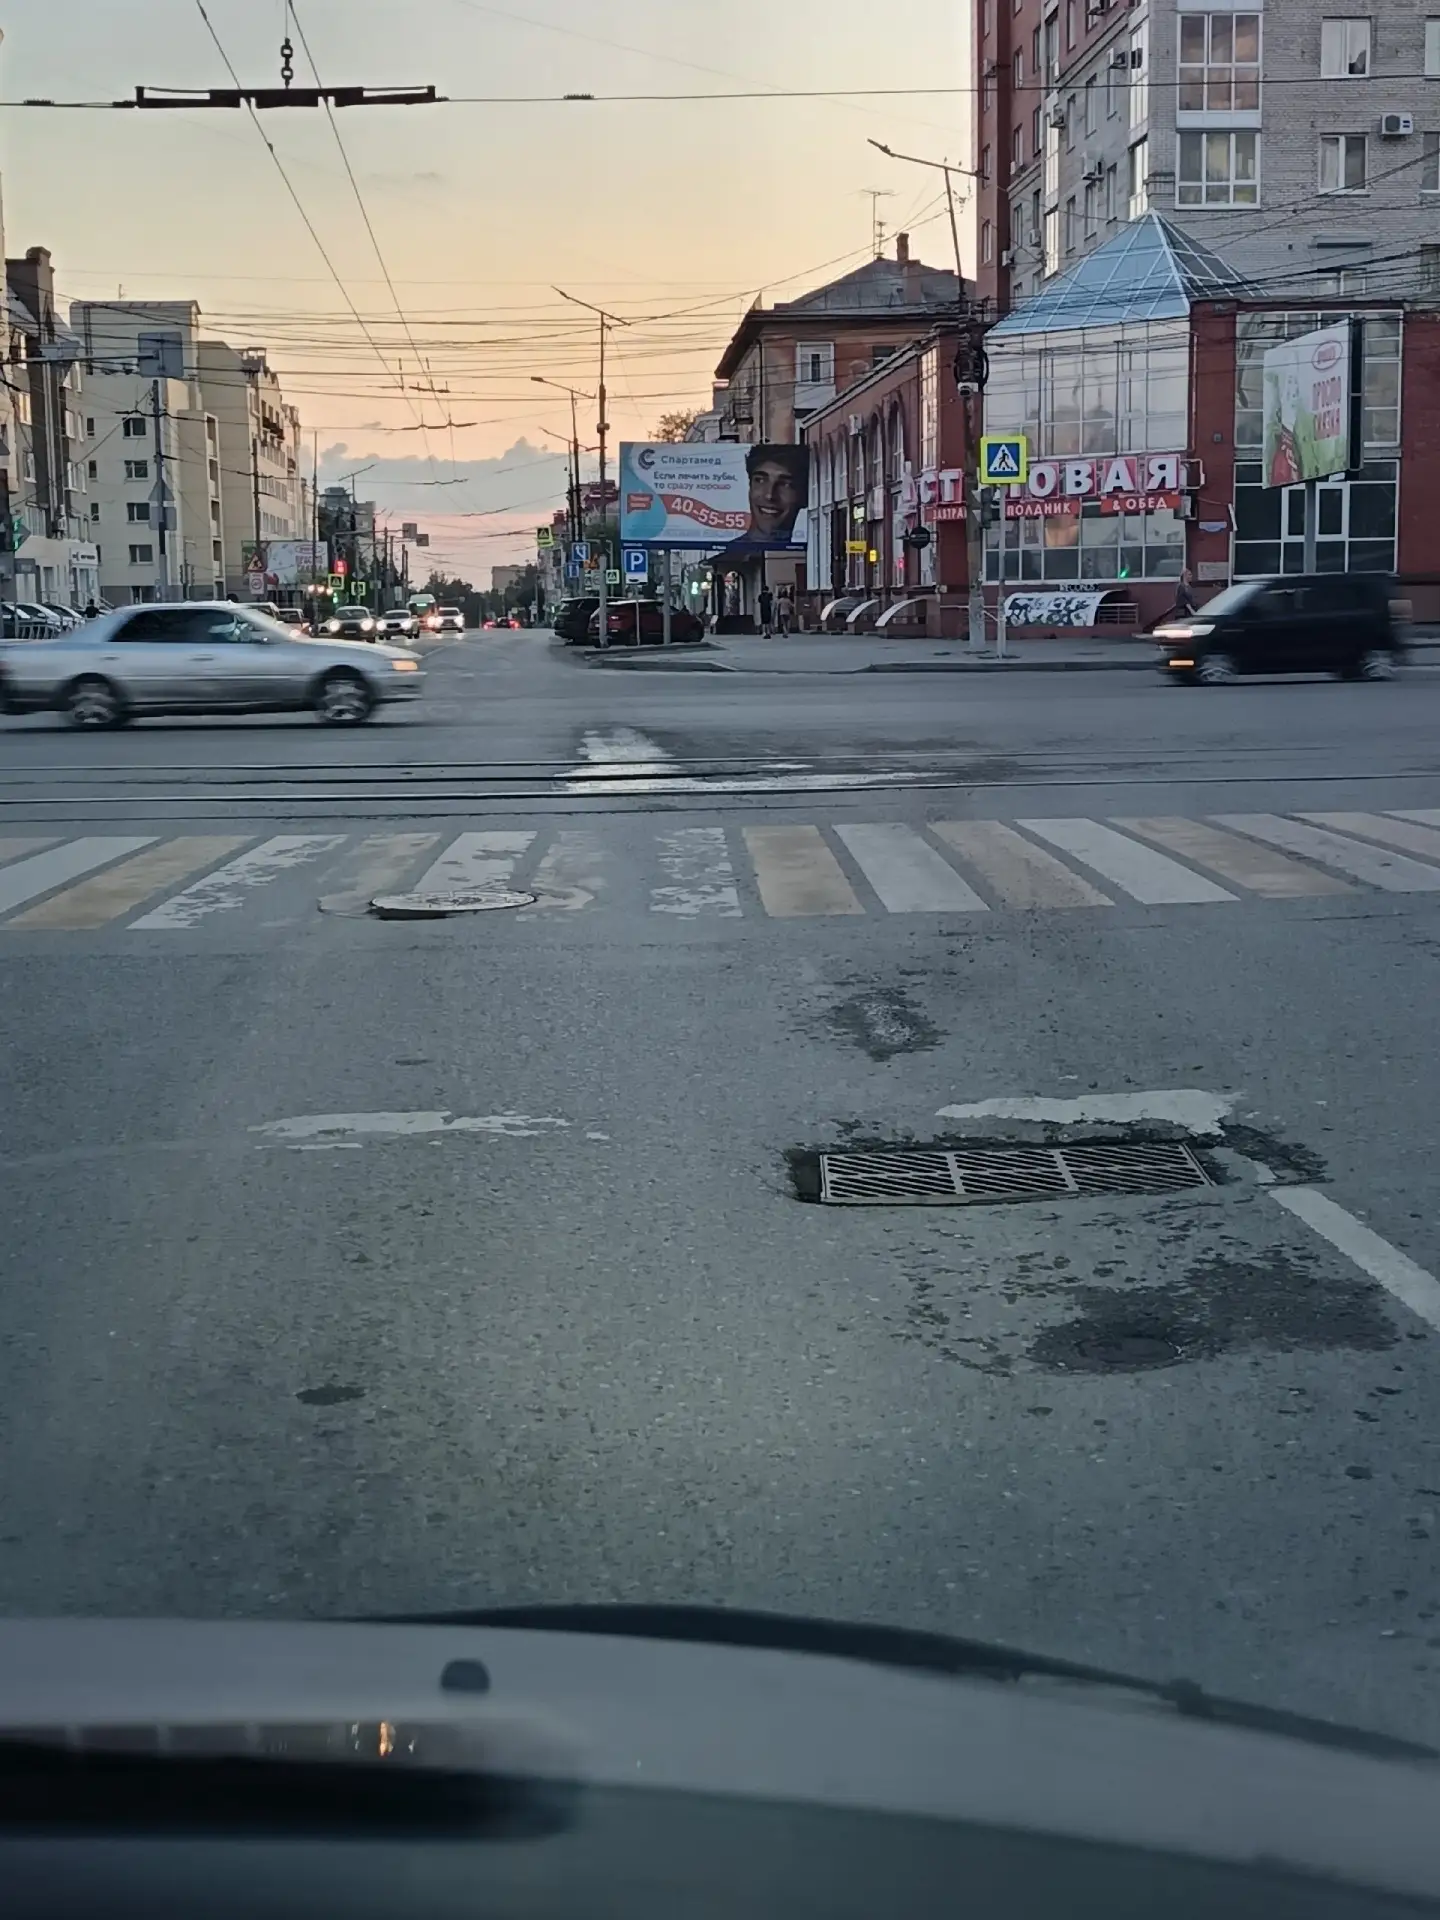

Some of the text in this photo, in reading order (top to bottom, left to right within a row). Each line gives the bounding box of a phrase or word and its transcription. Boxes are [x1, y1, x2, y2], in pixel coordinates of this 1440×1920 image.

[661, 455, 722, 466] Спартамед
[654, 471, 738, 482] Если лечить зубы,
[667, 482, 694, 490] сразу
[1006, 502, 1071, 516] ПОЛДНИК
[1125, 497, 1168, 510] ОБЕД
[671, 497, 745, 528] 40-55-55
